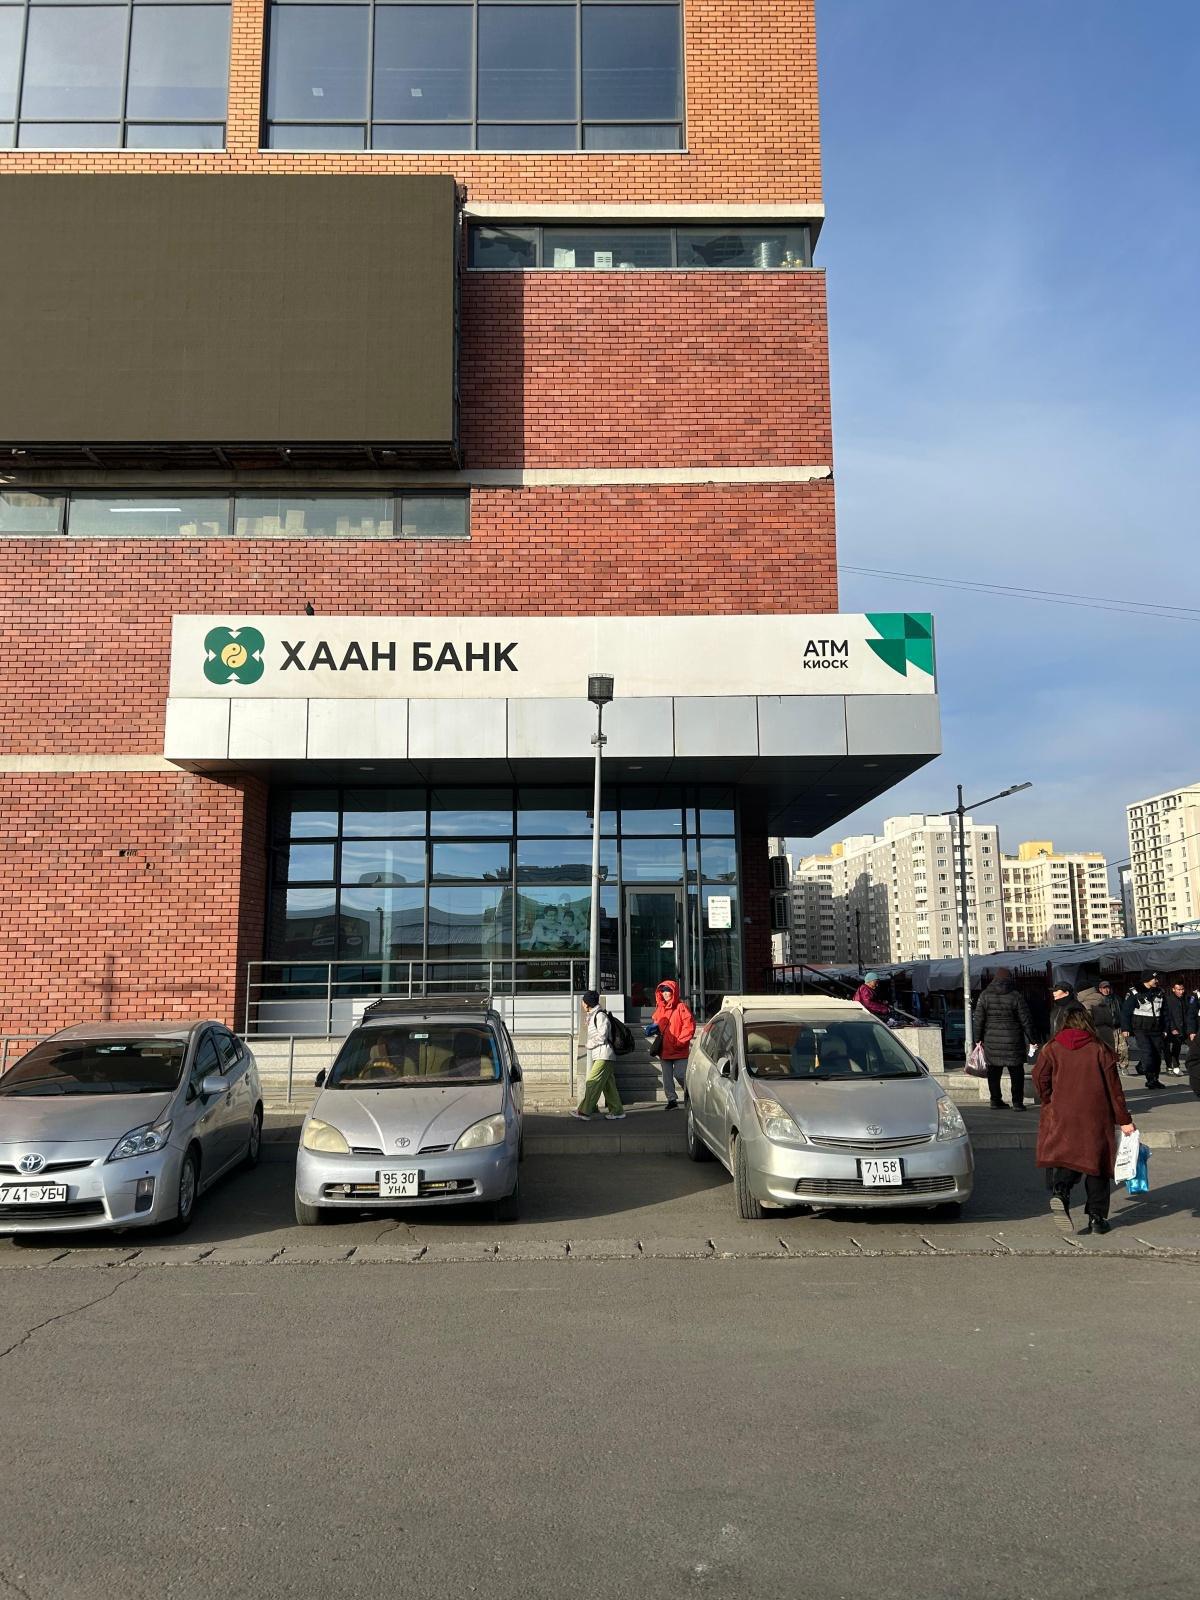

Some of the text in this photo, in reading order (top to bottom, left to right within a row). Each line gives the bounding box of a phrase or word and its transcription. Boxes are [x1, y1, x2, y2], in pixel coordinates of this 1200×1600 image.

[280, 640, 519, 672] ХААН БАНК
[803, 659, 849, 669] КИОСК
[864, 1161, 897, 1173] 71 58
[383, 1172, 415, 1184] 95 30
[872, 1174, 891, 1183] УНЦ
[40, 1187, 65, 1200] УБЧ
